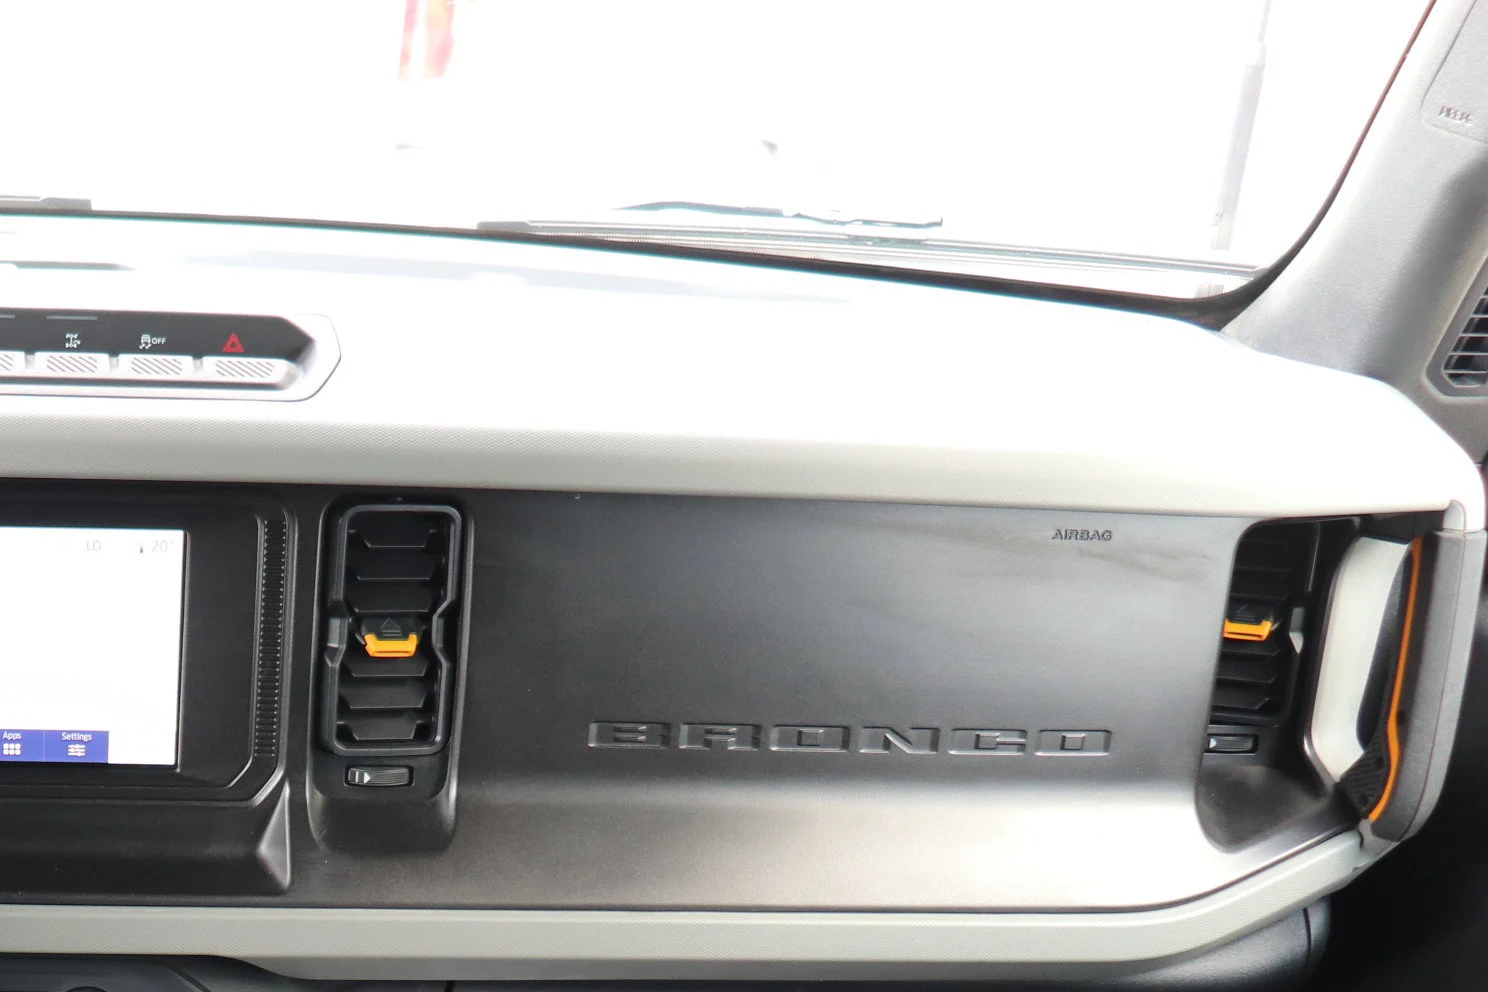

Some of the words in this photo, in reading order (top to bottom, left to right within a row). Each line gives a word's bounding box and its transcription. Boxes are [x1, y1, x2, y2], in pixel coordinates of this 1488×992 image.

[151, 336, 166, 346] OFF
[1051, 528, 1113, 542] AIRBAG
[3, 732, 22, 741] Apps
[62, 732, 93, 742] Settings
[587, 720, 1113, 756] BRONCO
